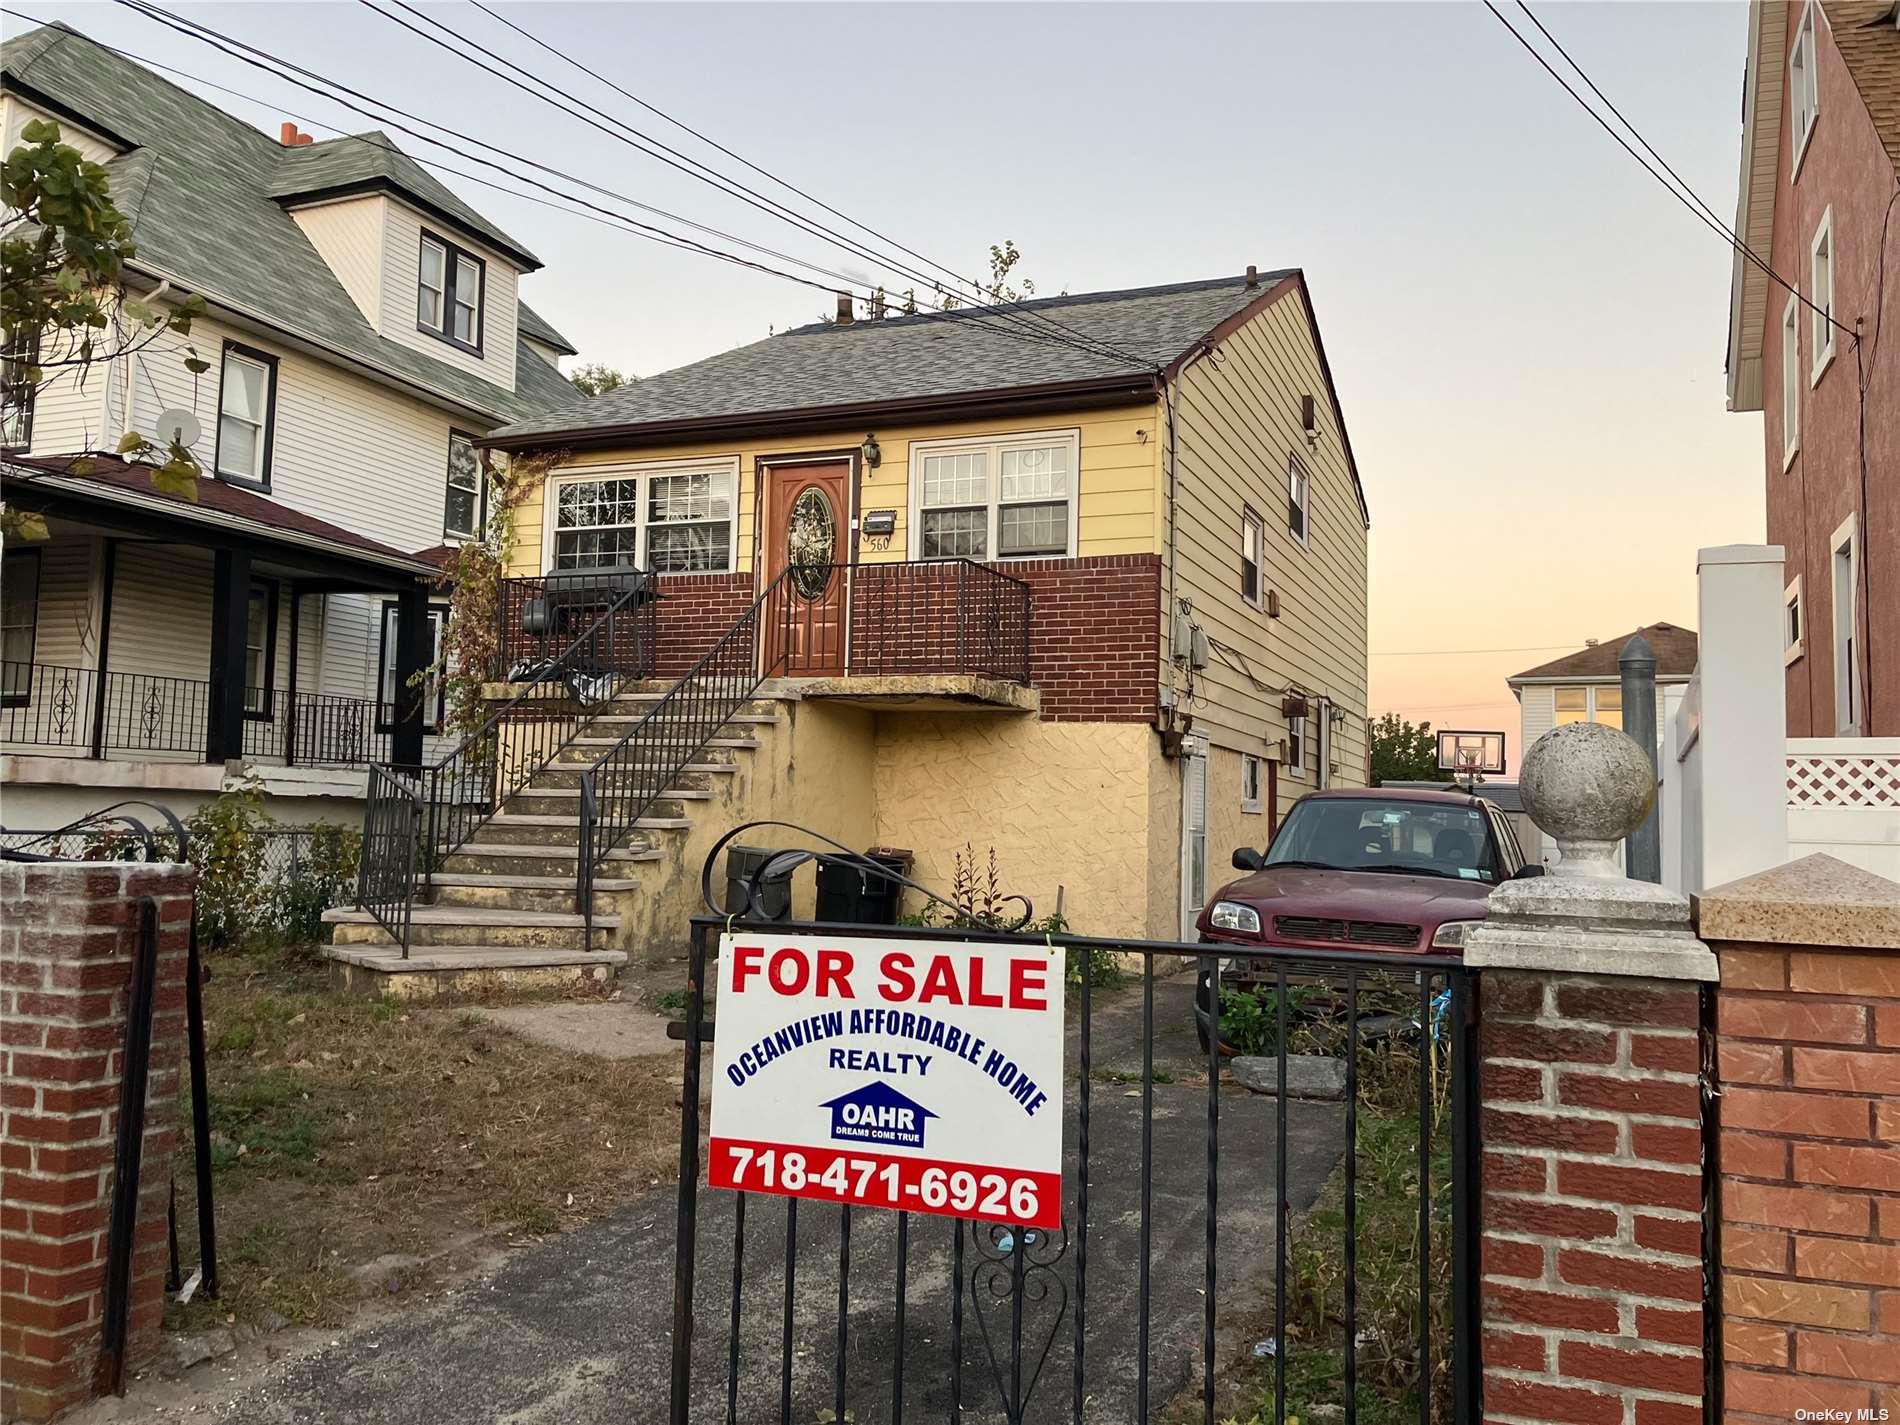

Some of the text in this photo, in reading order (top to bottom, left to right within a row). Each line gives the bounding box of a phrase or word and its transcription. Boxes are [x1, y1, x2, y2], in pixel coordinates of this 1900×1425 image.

[870, 537, 889, 552] 560
[731, 946, 1048, 1011] FOR SALE
[726, 1008, 1048, 1117] OCEANVIEW AFFORDABLE HOME
[828, 1047, 933, 1076] REALTY
[841, 1103, 915, 1131] OAHR
[835, 1126, 921, 1143] DREAMS COME TRUE
[728, 1146, 1039, 1220] 718-471-6926
